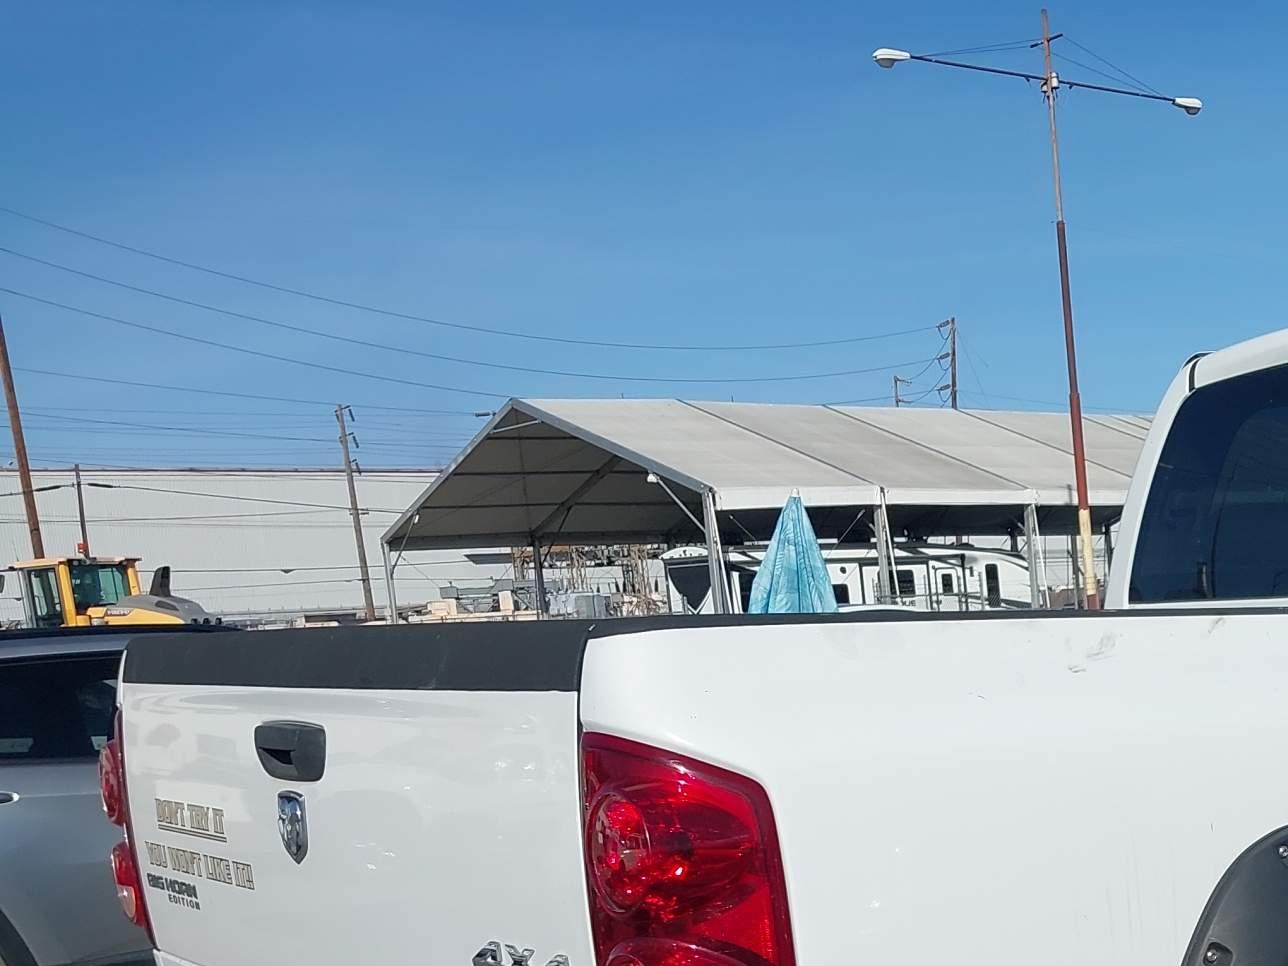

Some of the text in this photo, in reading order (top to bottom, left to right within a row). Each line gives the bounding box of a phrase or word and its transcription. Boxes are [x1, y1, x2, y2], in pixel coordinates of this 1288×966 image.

[211, 807, 225, 835] IT
[144, 840, 168, 868] YOU
[202, 854, 233, 885] LIKE
[146, 872, 199, 900] BIG HORN
[167, 893, 201, 911] EDITION
